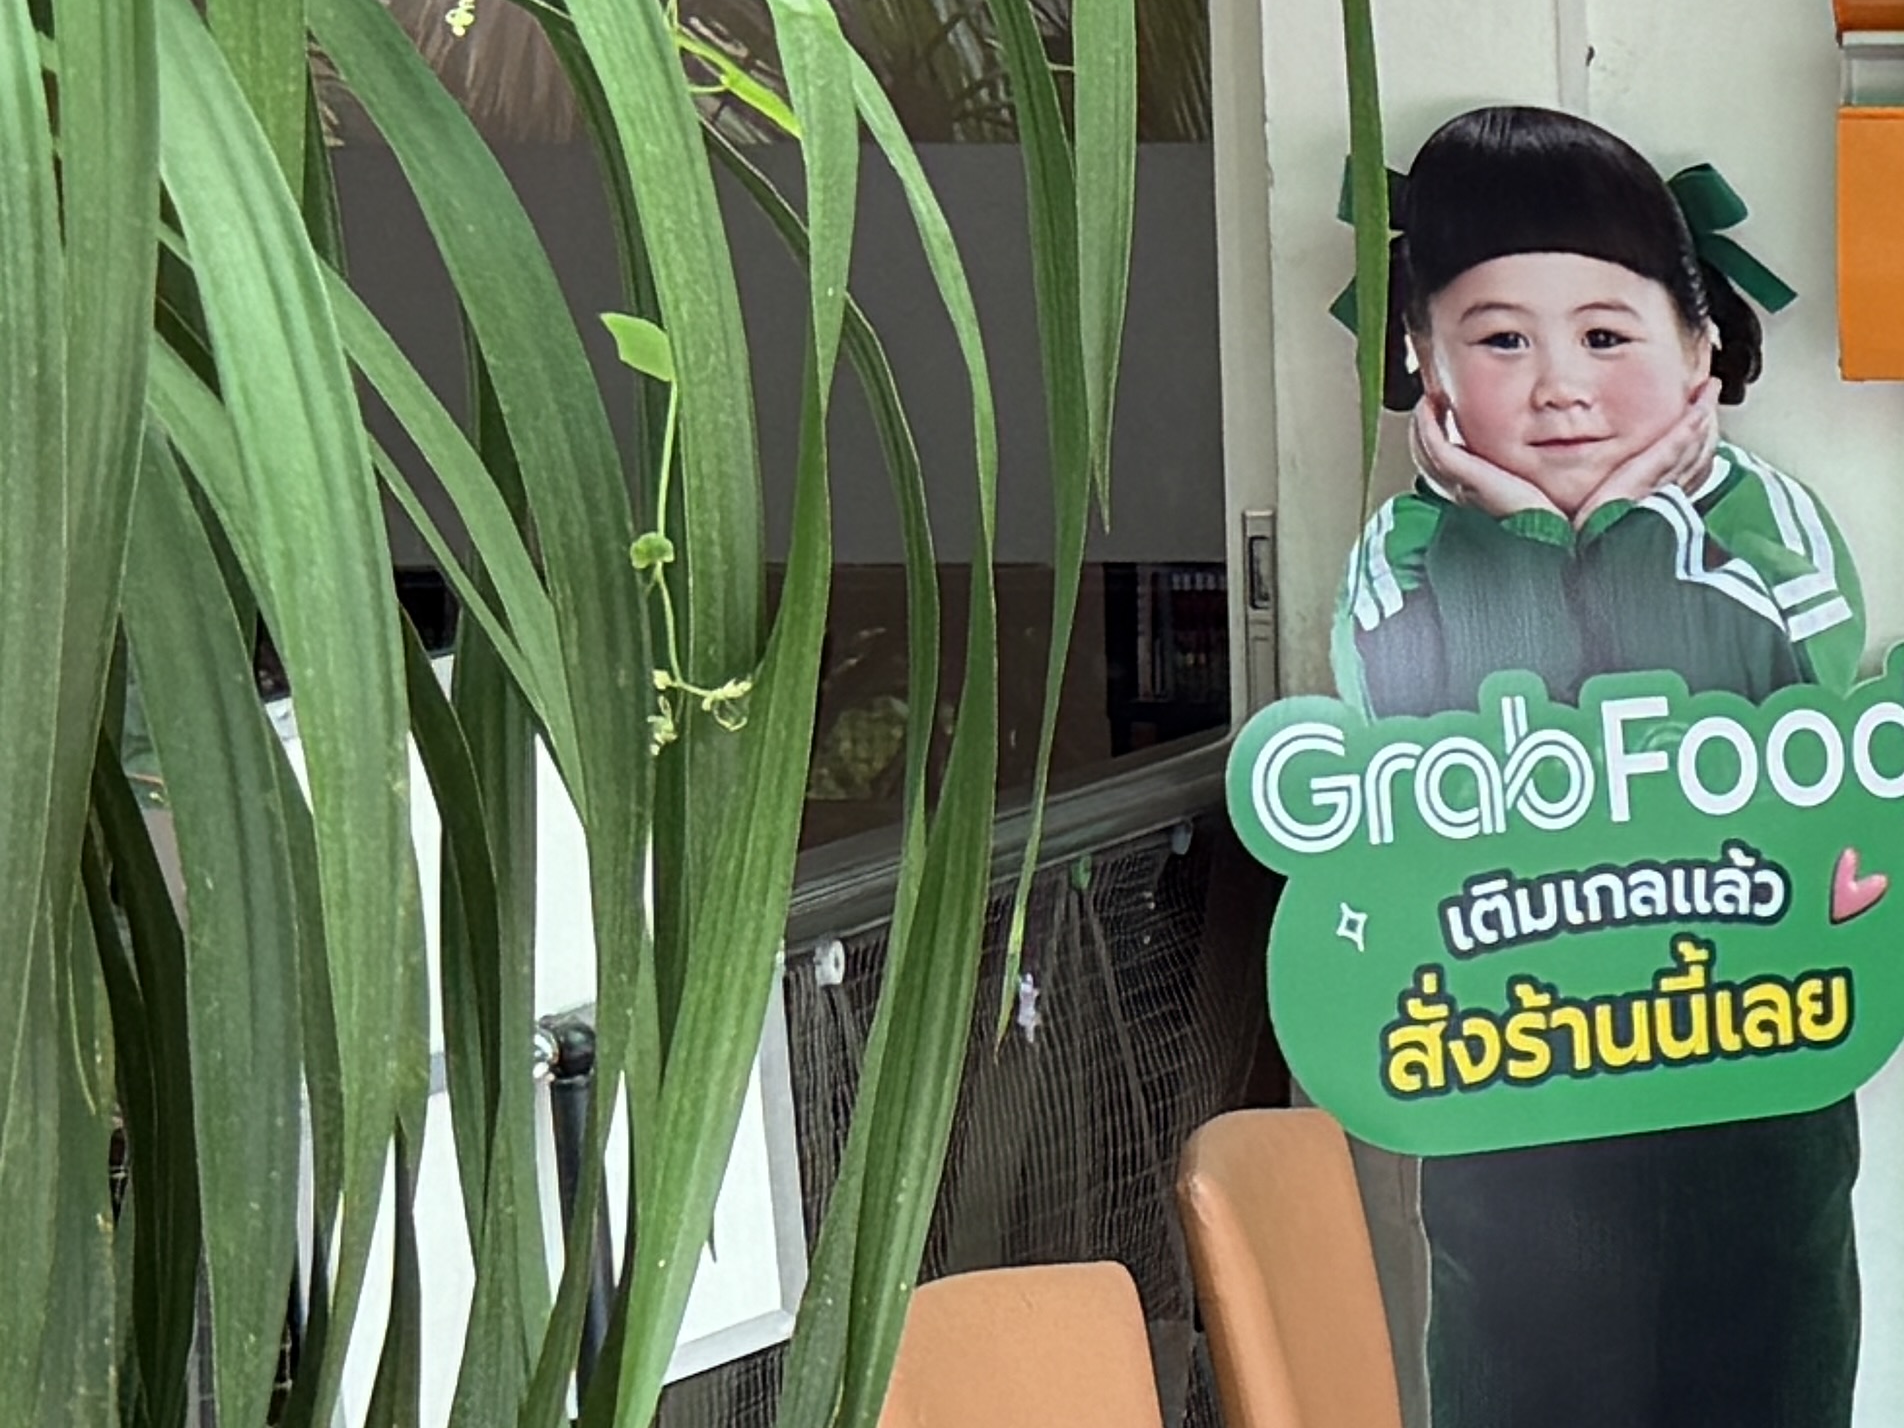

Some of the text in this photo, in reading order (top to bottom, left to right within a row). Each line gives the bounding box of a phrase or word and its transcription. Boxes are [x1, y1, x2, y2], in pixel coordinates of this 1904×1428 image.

[1447, 847, 1785, 951] เติมเกลแล้ว
[1387, 940, 1848, 1092] สั่งร้านนี้เลย
